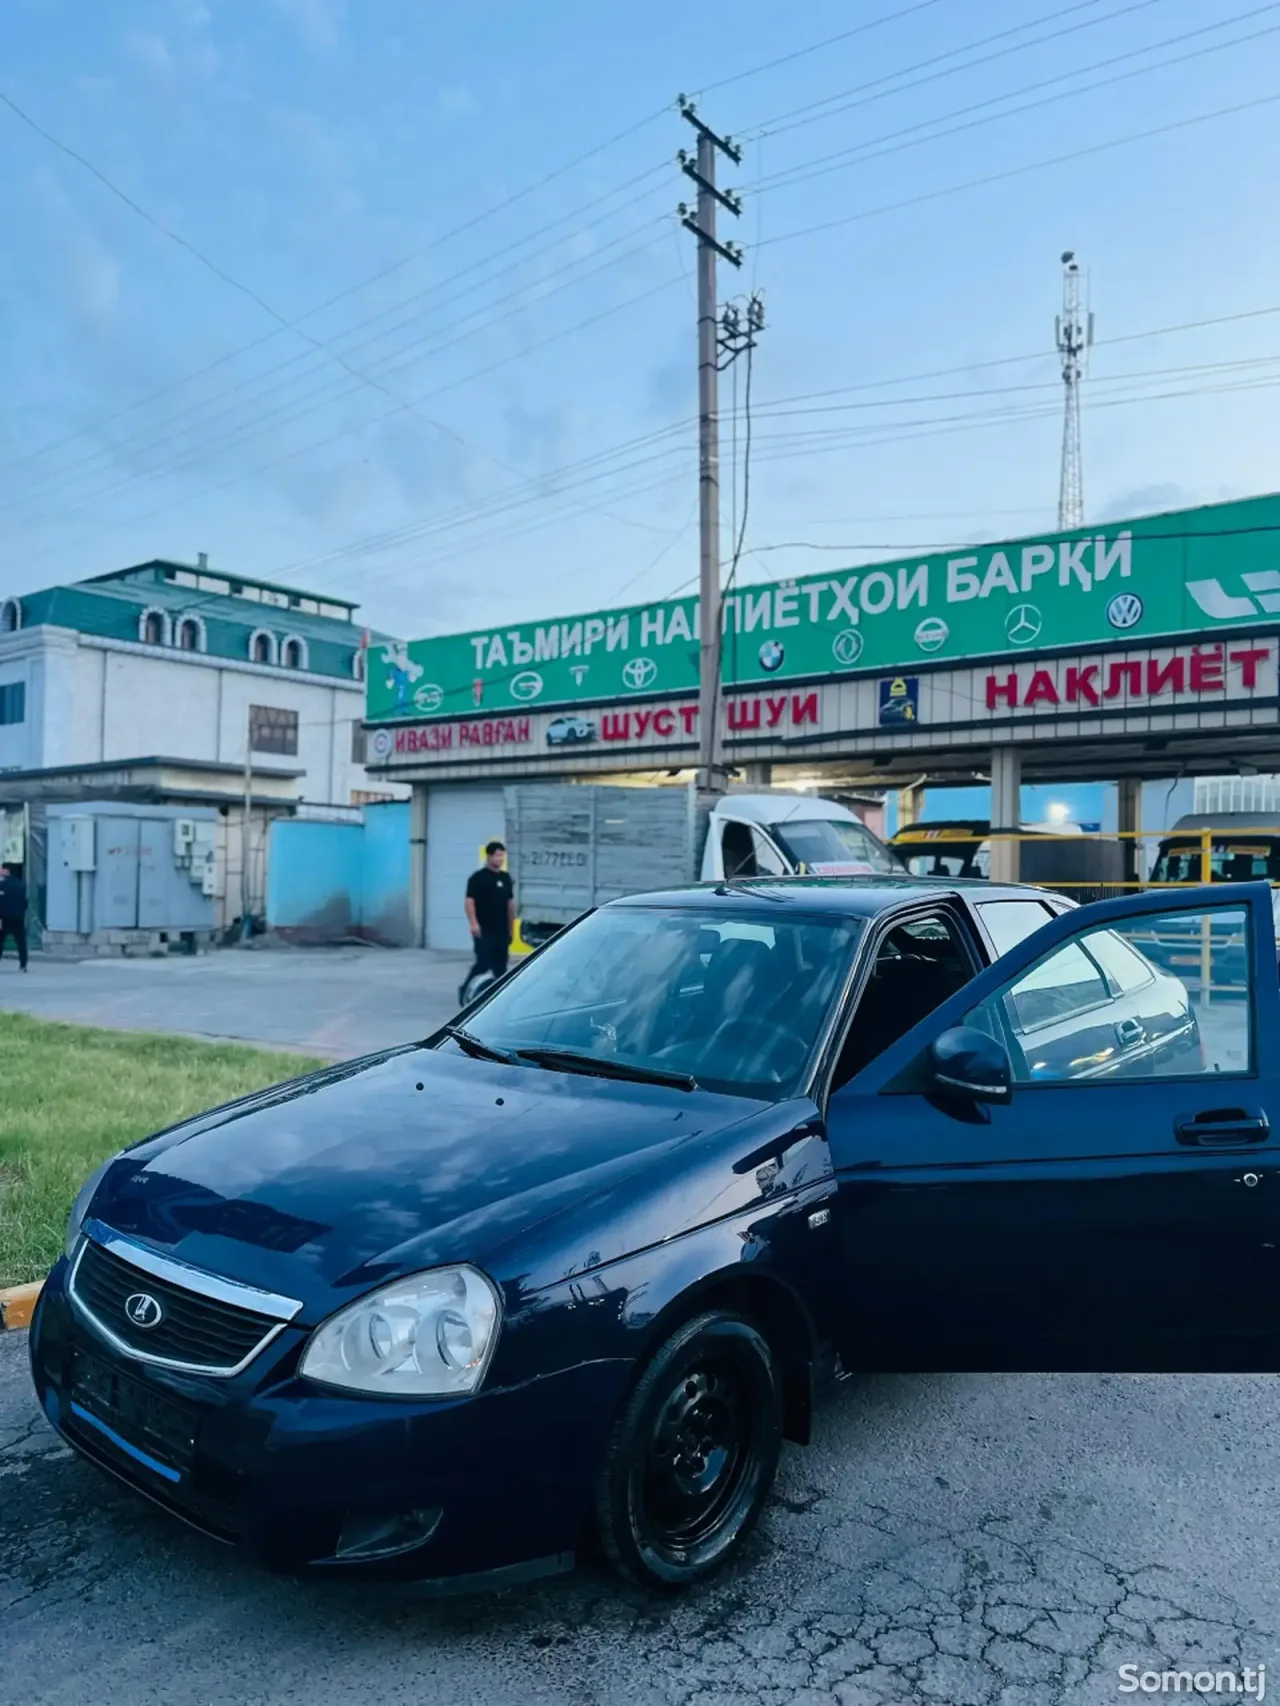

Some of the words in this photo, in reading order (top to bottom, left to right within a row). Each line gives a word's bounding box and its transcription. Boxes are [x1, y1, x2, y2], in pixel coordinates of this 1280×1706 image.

[471, 614, 629, 670] ТАЪМИРИ
[640, 564, 929, 648] НАЛИЁТҲОИ
[946, 530, 1132, 603] БАРҚИ
[985, 644, 1270, 710] НАҚЛИЁТ
